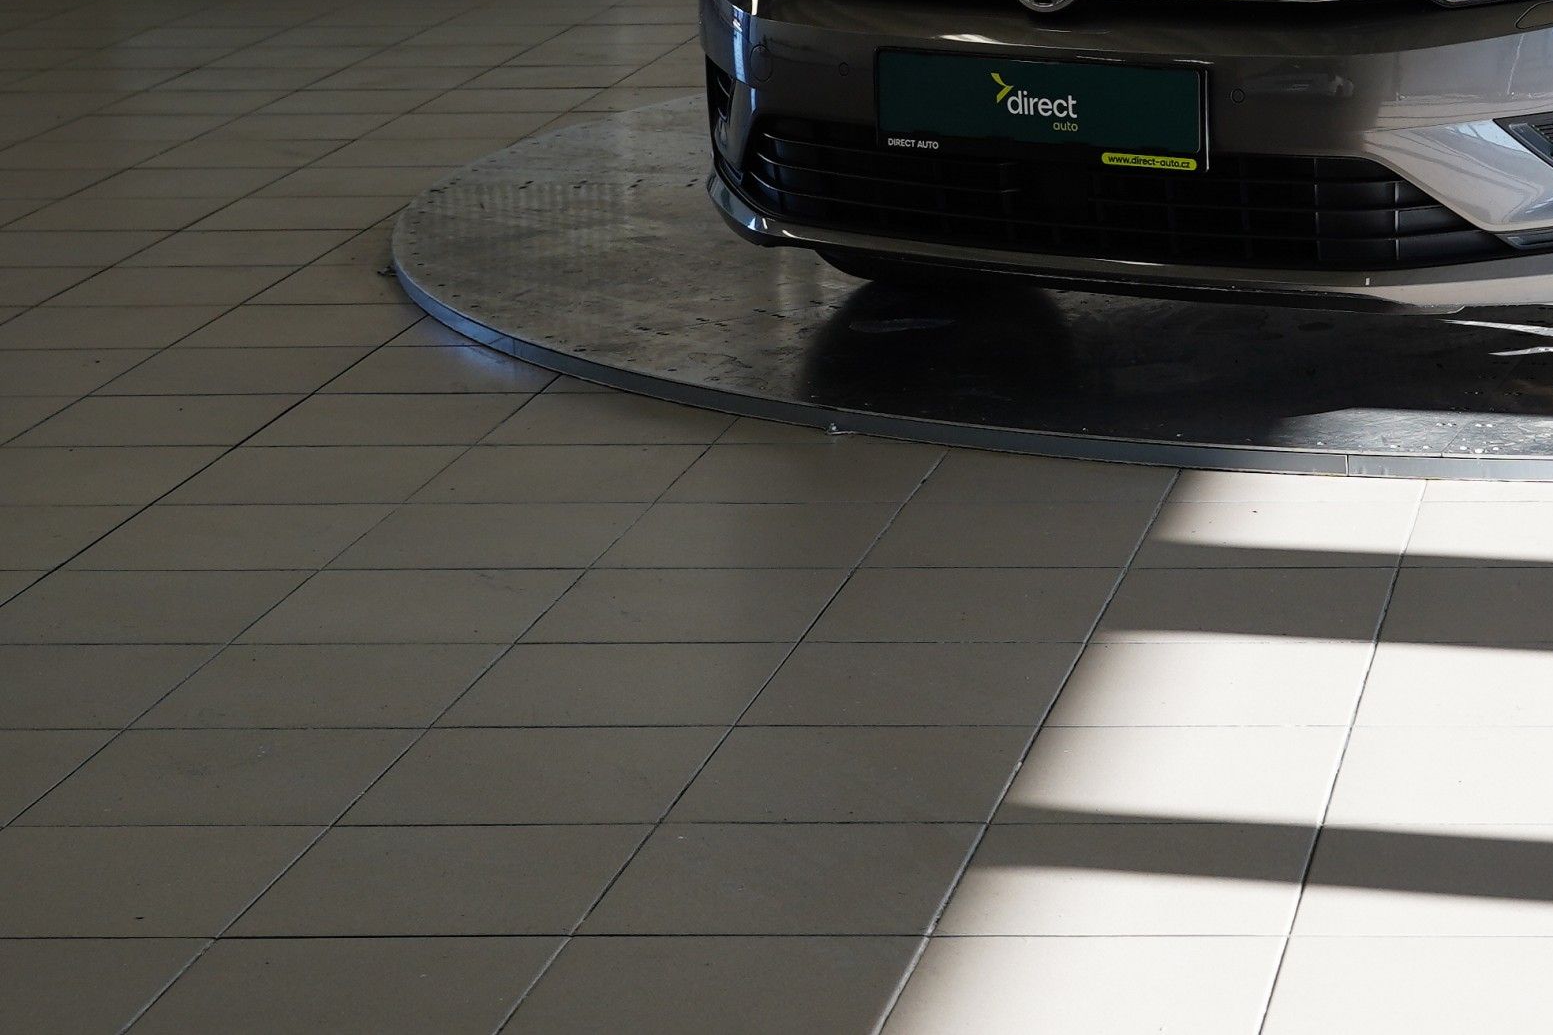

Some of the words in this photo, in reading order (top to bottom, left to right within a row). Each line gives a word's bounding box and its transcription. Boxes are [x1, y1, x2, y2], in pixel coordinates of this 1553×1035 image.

[1007, 91, 1078, 119] direct
[1053, 121, 1078, 132] auto
[887, 138, 915, 148] DIRECT
[917, 139, 939, 149] AUTO
[1107, 155, 1191, 169] www.direct-auto.cz
